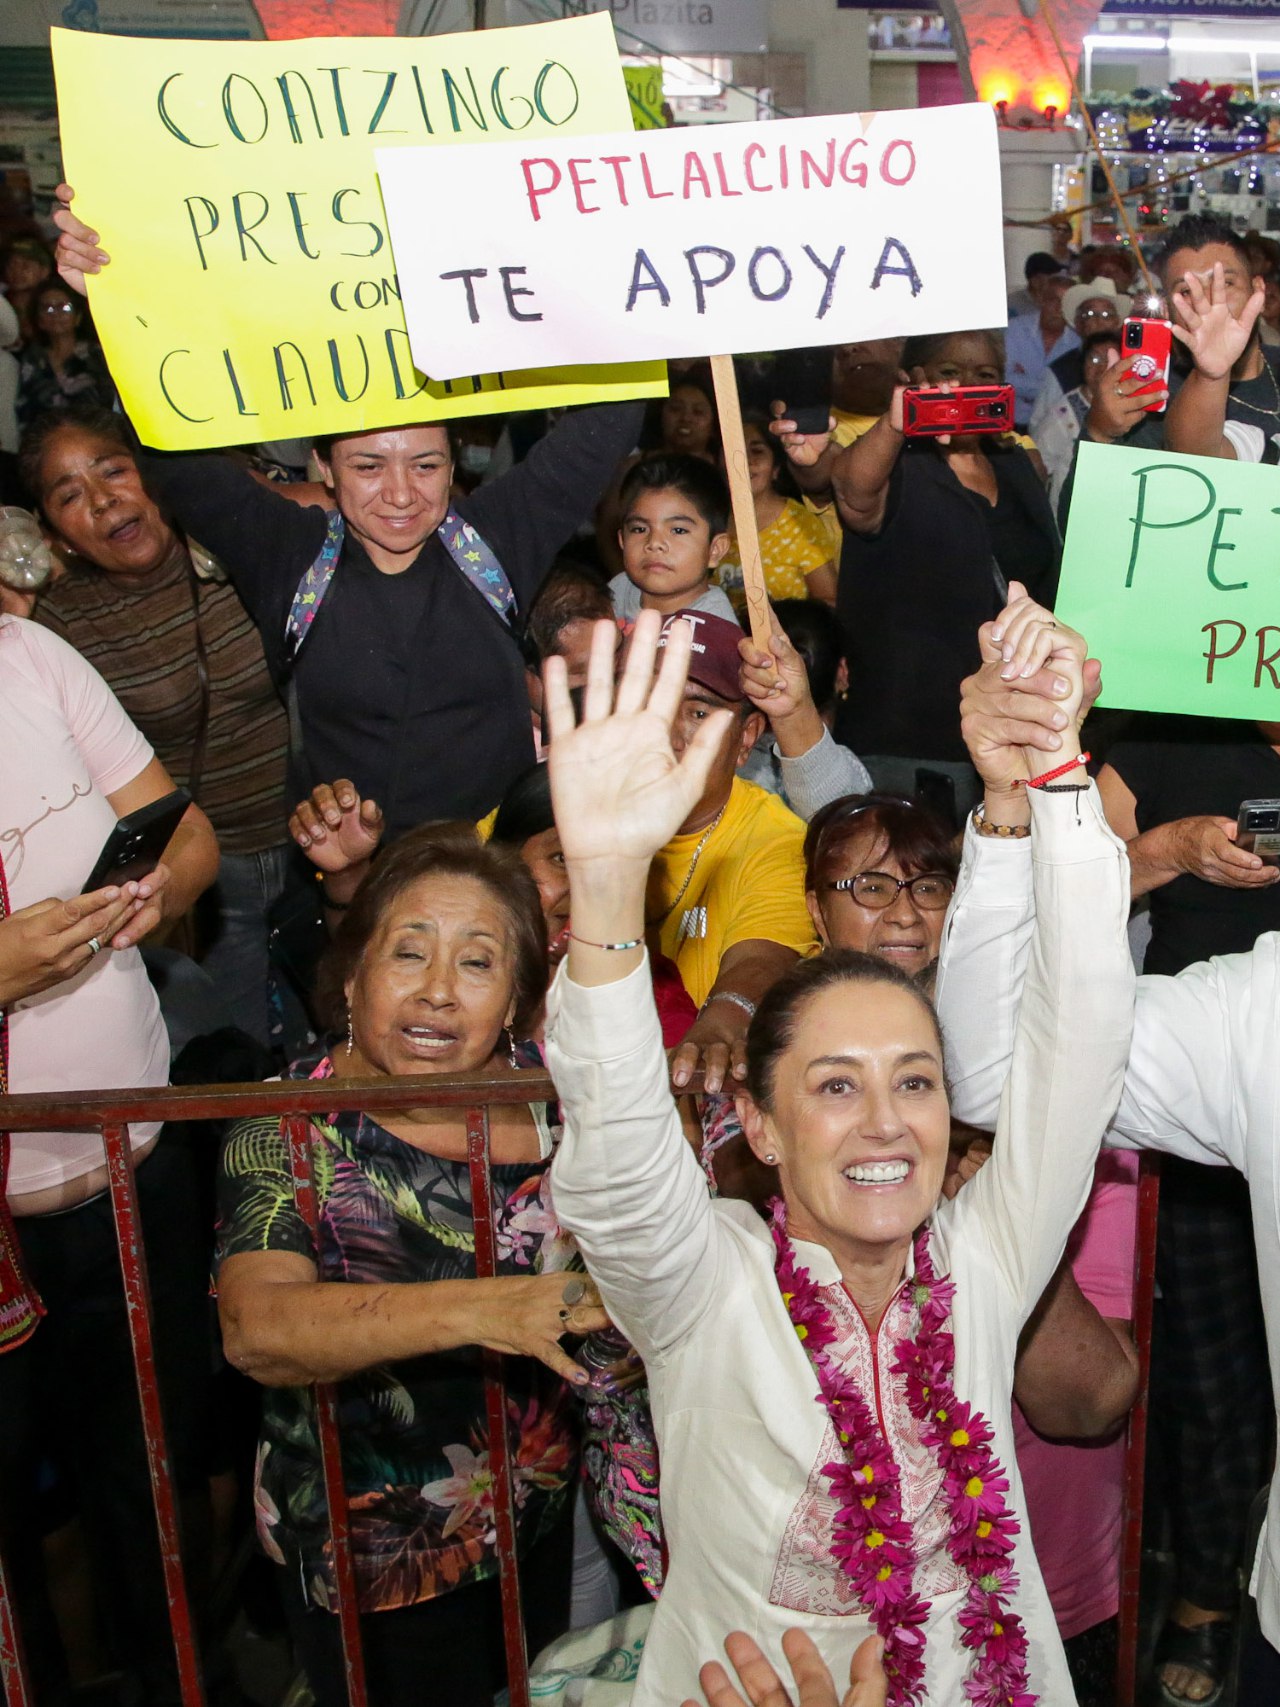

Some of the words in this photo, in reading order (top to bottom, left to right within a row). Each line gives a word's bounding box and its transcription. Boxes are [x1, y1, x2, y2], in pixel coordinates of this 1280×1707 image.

[158, 60, 579, 150] COATZINGO
[520, 138, 917, 222] PETLALCINGO
[187, 190, 384, 271] PRES
[331, 274, 402, 313] CON
[439, 266, 544, 324] TE
[625, 237, 924, 320] APOYA
